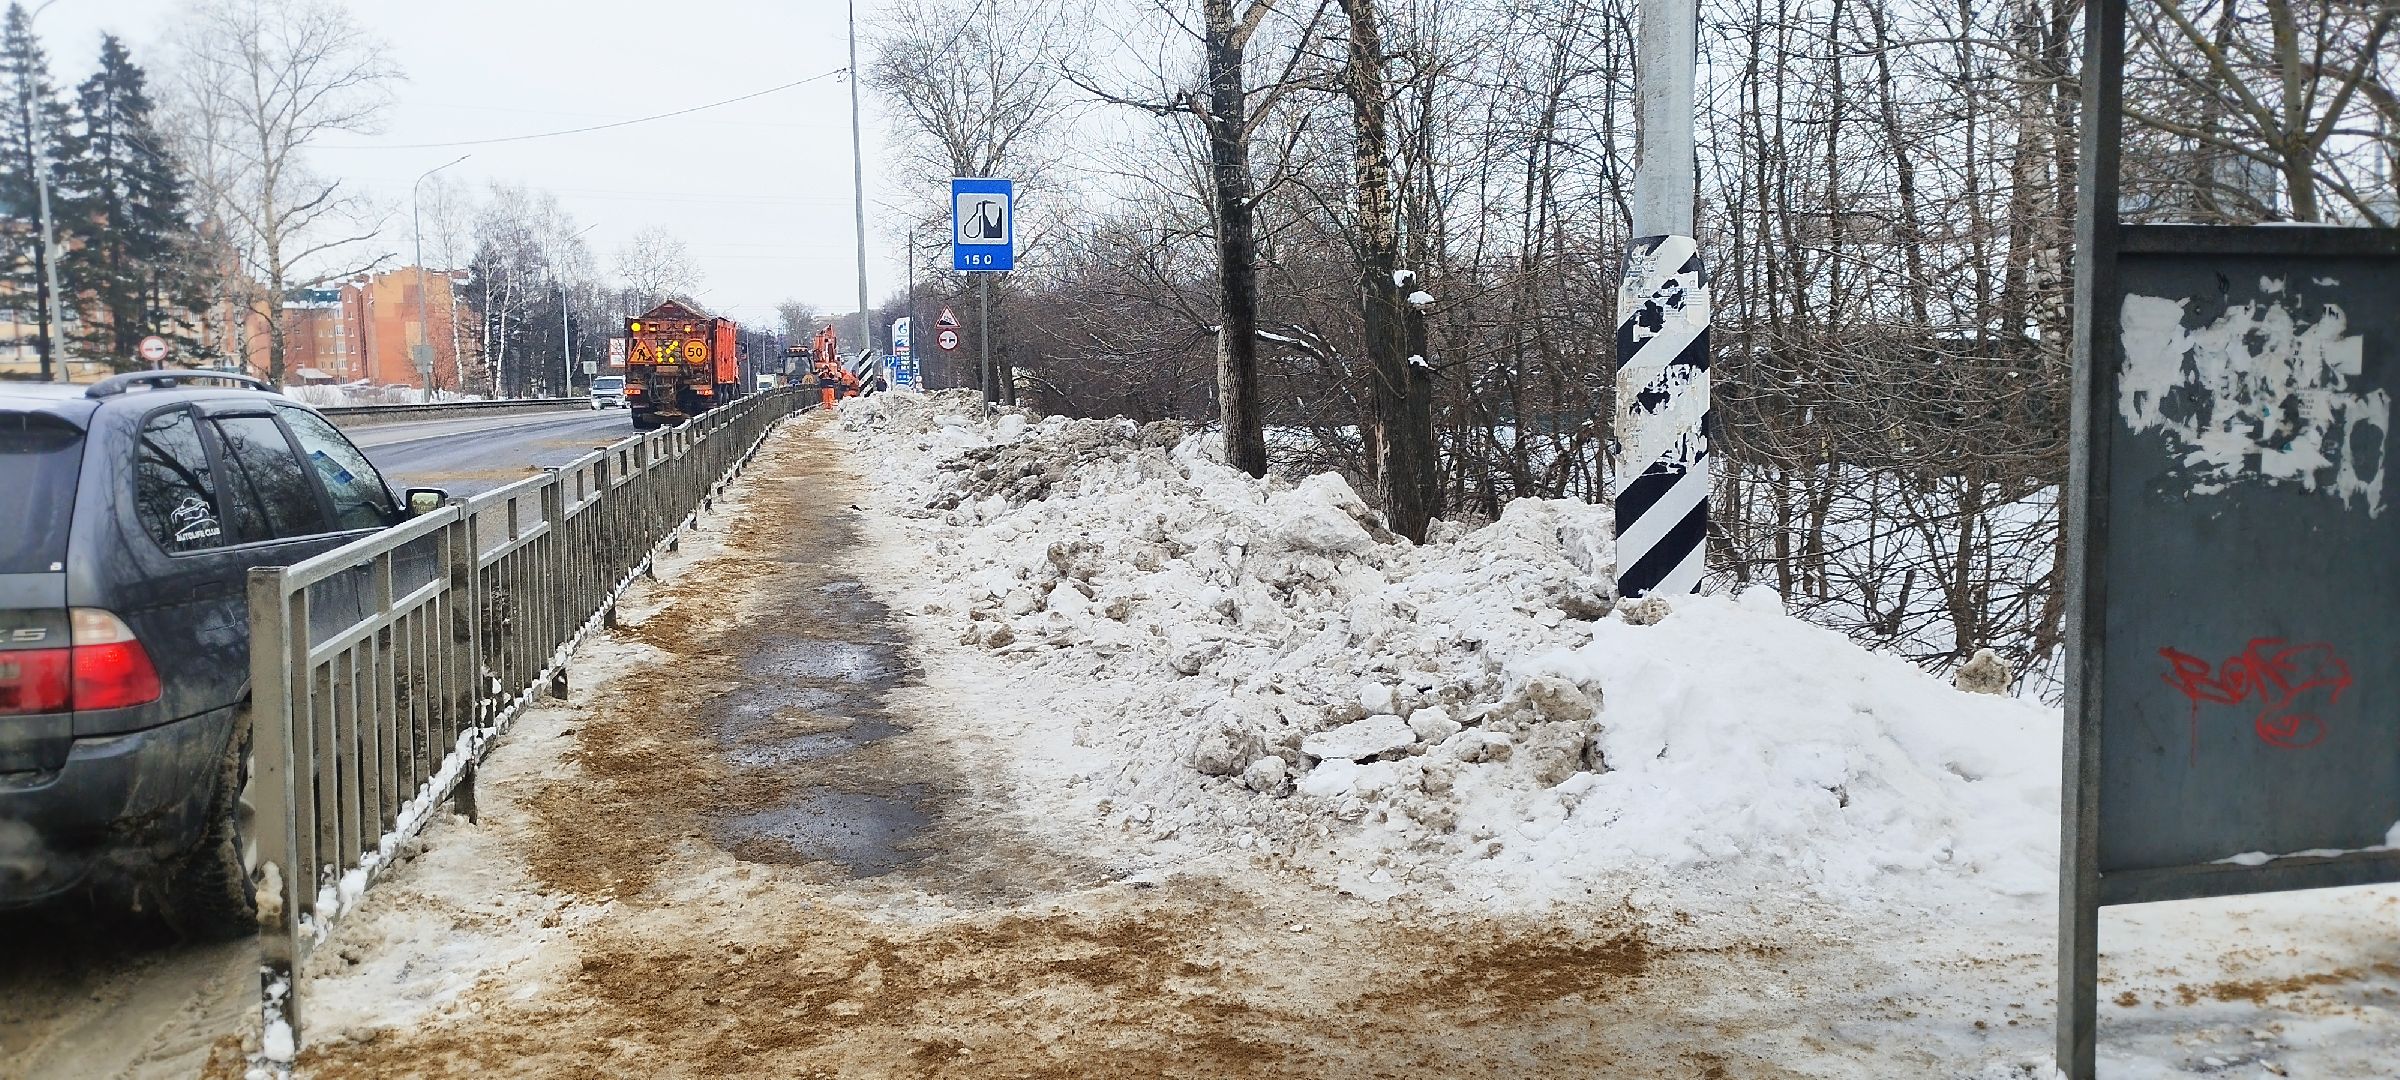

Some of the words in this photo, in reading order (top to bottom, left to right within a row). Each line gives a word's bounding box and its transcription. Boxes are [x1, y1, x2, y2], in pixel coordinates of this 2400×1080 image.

[964, 254, 992, 265] 150
[687, 347, 703, 357] 50
[204, 527, 221, 538] CLUB
